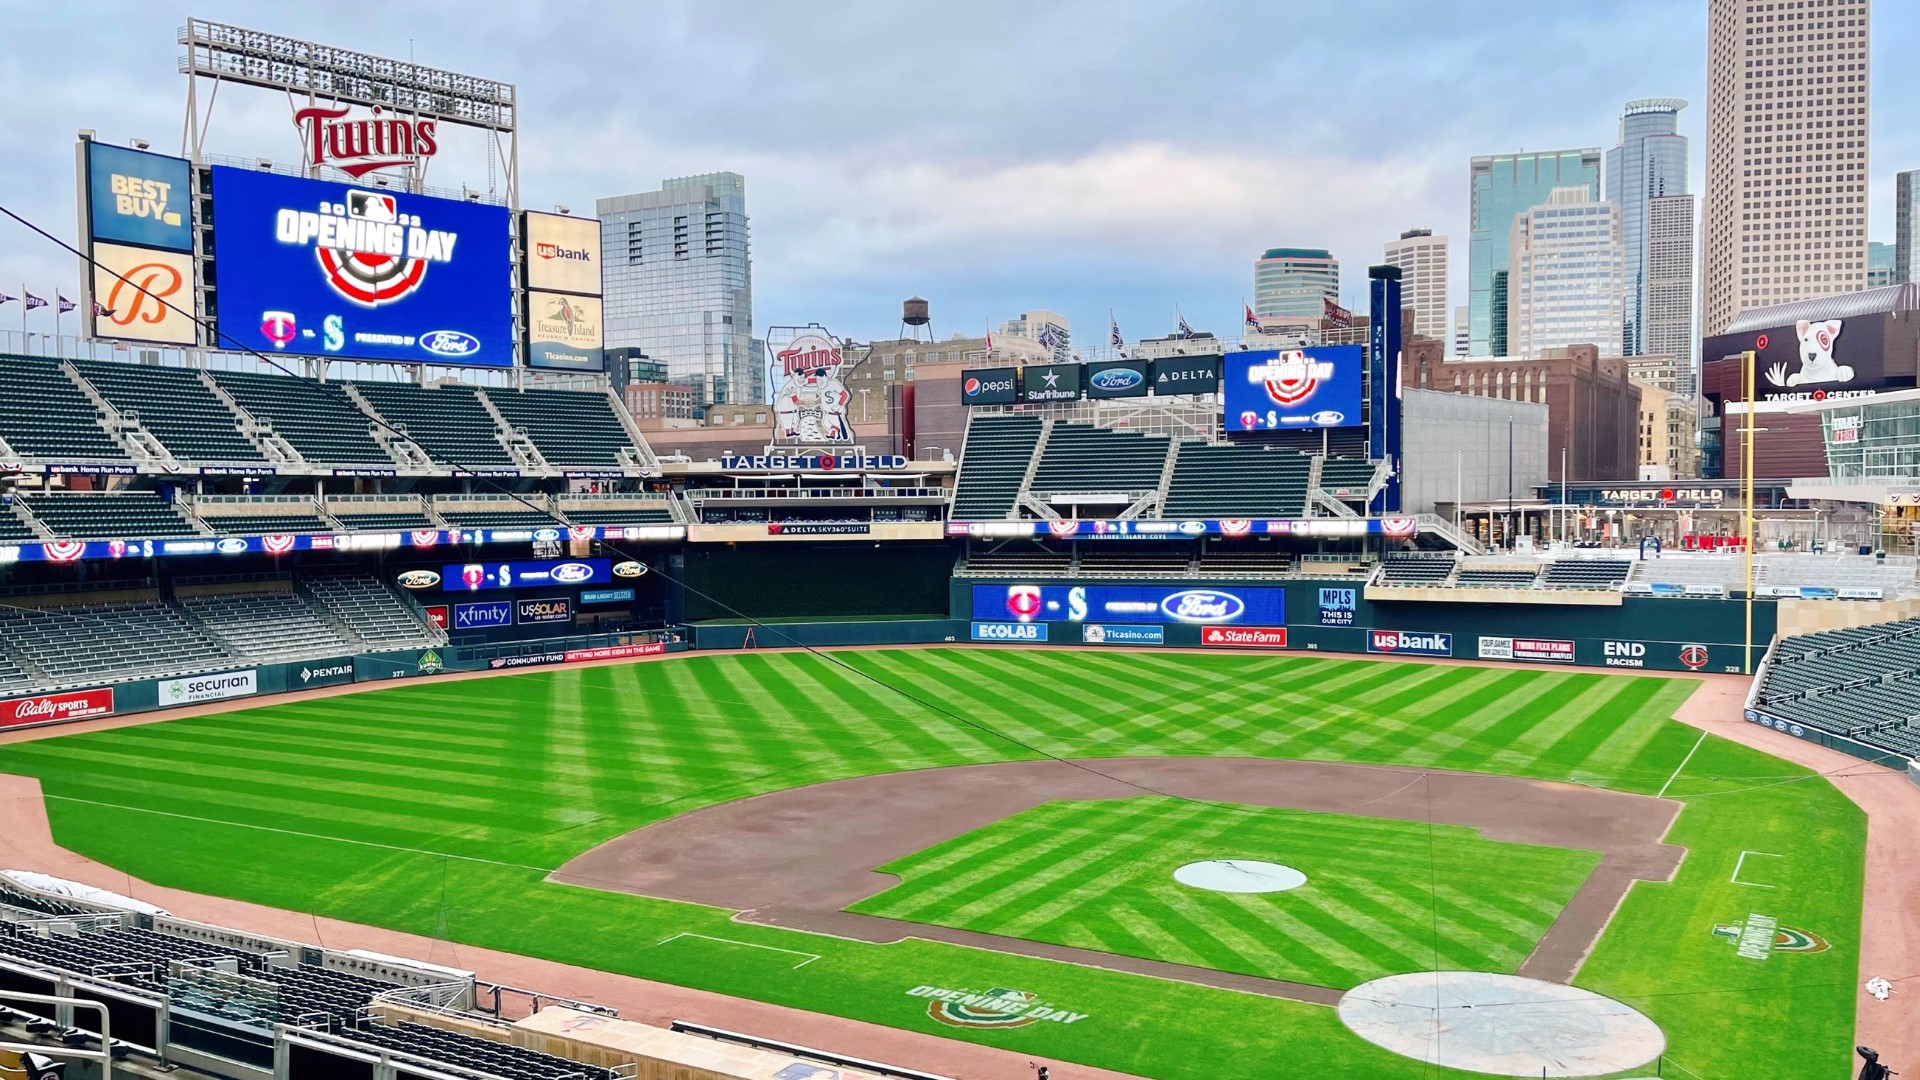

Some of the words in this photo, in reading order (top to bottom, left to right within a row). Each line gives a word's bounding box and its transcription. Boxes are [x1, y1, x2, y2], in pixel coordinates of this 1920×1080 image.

[293, 104, 438, 168] Twins
[111, 173, 171, 202] BEST
[117, 194, 167, 220] BUY
[276, 208, 405, 255] OPENING
[408, 227, 458, 262] DAY
[108, 263, 182, 326] B
[536, 321, 567, 334] Treasure
[574, 324, 595, 337] Island
[355, 332, 403, 345] PRESENTED
[404, 336, 415, 346] BY
[430, 333, 468, 352] Ford
[777, 346, 843, 377] Twins
[1101, 371, 1132, 387] Ford
[1171, 369, 1213, 381] DELTA
[1249, 363, 1305, 382] OPENING
[1307, 362, 1334, 378] DAY
[982, 378, 1014, 393] pepsi
[1028, 389, 1075, 400] StarTribune
[1765, 392, 1812, 402] TARGET
[1827, 389, 1876, 400] CENTER
[722, 456, 816, 469] TARGET
[841, 456, 908, 469] FIELD
[81, 466, 99, 474] Home
[101, 466, 113, 474] Run
[115, 466, 133, 474] Porch
[1602, 490, 1659, 500] TARGET
[1676, 489, 1723, 500] FIELD
[559, 566, 585, 580] Ford
[619, 563, 642, 575] Ford
[405, 573, 431, 586] Ford
[1323, 589, 1351, 604] MPLS
[1177, 593, 1227, 616] Ford
[459, 606, 508, 625] xfinity
[1322, 611, 1342, 619] THIS
[1343, 611, 1353, 619] IS
[979, 625, 1038, 638] ECOLAB
[1106, 630, 1162, 640] TIcasino.com
[1481, 639, 1493, 648] YOUR
[1536, 642, 1550, 650] FLEX
[1604, 642, 1646, 657] END
[567, 652, 593, 660] GETTING
[594, 649, 611, 657] MORE
[645, 645, 661, 653] GAME
[507, 656, 545, 666] COMMUNITY
[546, 654, 563, 663] FUND
[1606, 658, 1643, 667] RACISM
[313, 665, 352, 678] PENTAIR
[1725, 665, 1740, 673] 328
[188, 675, 249, 693] securian
[189, 691, 225, 700] FINANCIAL
[15, 699, 57, 718] Bally
[58, 699, 88, 712] SPORTS
[905, 985, 1029, 1014] OPENING
[1026, 1006, 1089, 1024] DAY
